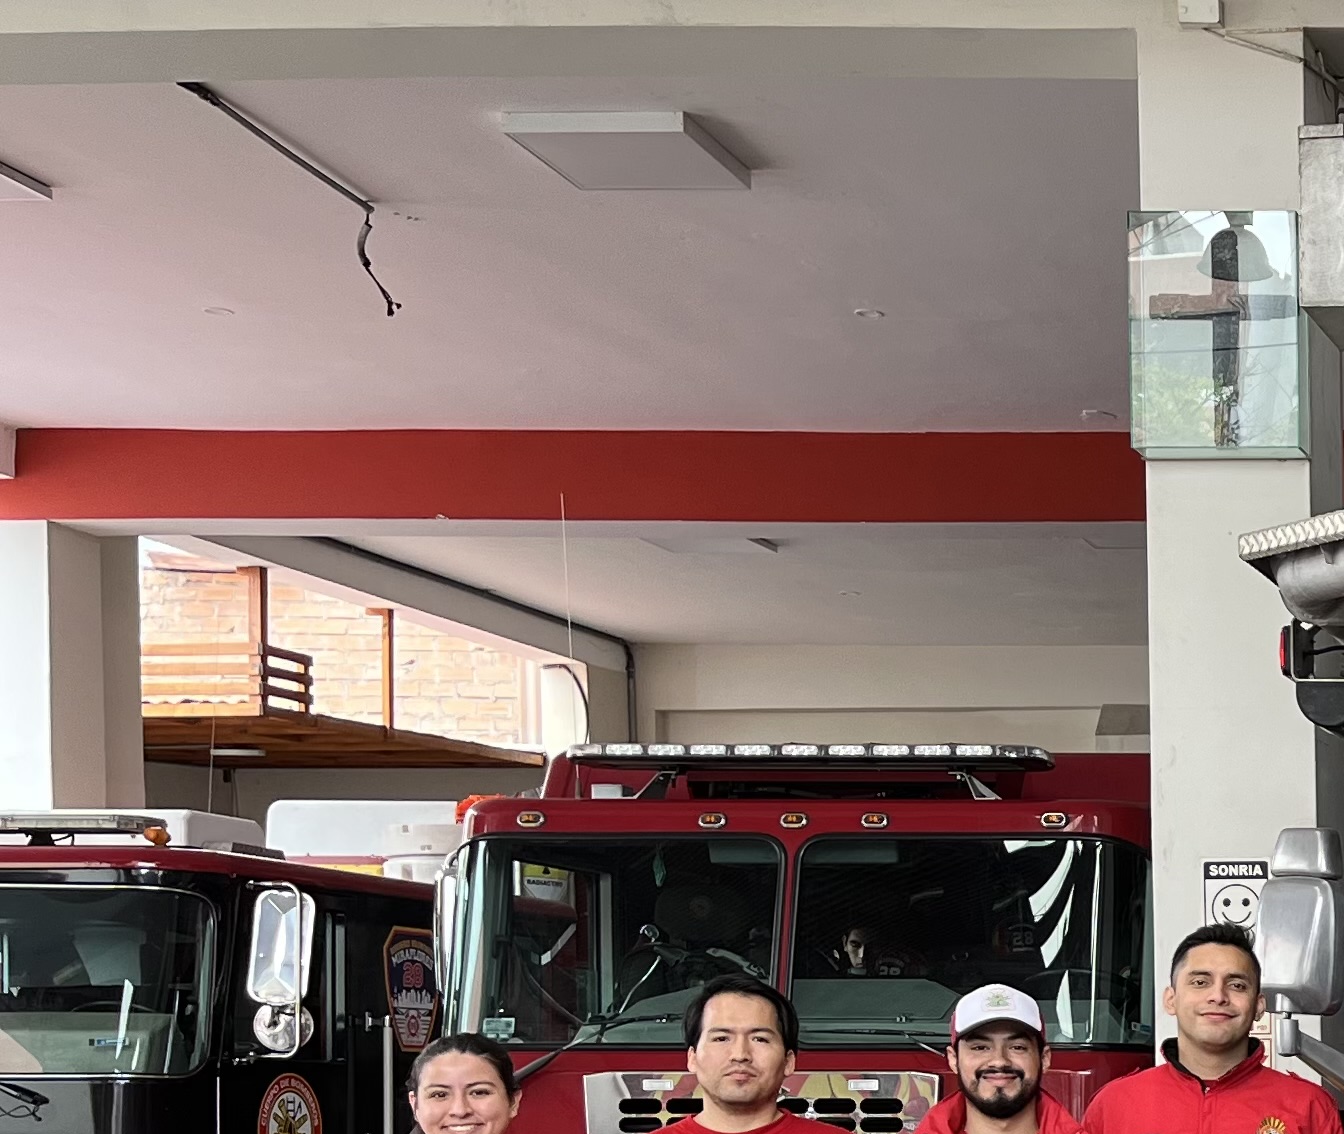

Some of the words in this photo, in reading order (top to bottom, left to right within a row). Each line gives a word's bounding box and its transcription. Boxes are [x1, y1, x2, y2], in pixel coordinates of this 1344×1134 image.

[1208, 864, 1264, 877] SONRIA
[402, 961, 424, 988] 28
[260, 1084, 280, 1127] CUERPO
[280, 1078, 290, 1089] DE
[291, 1078, 319, 1127] BOMBEROS
